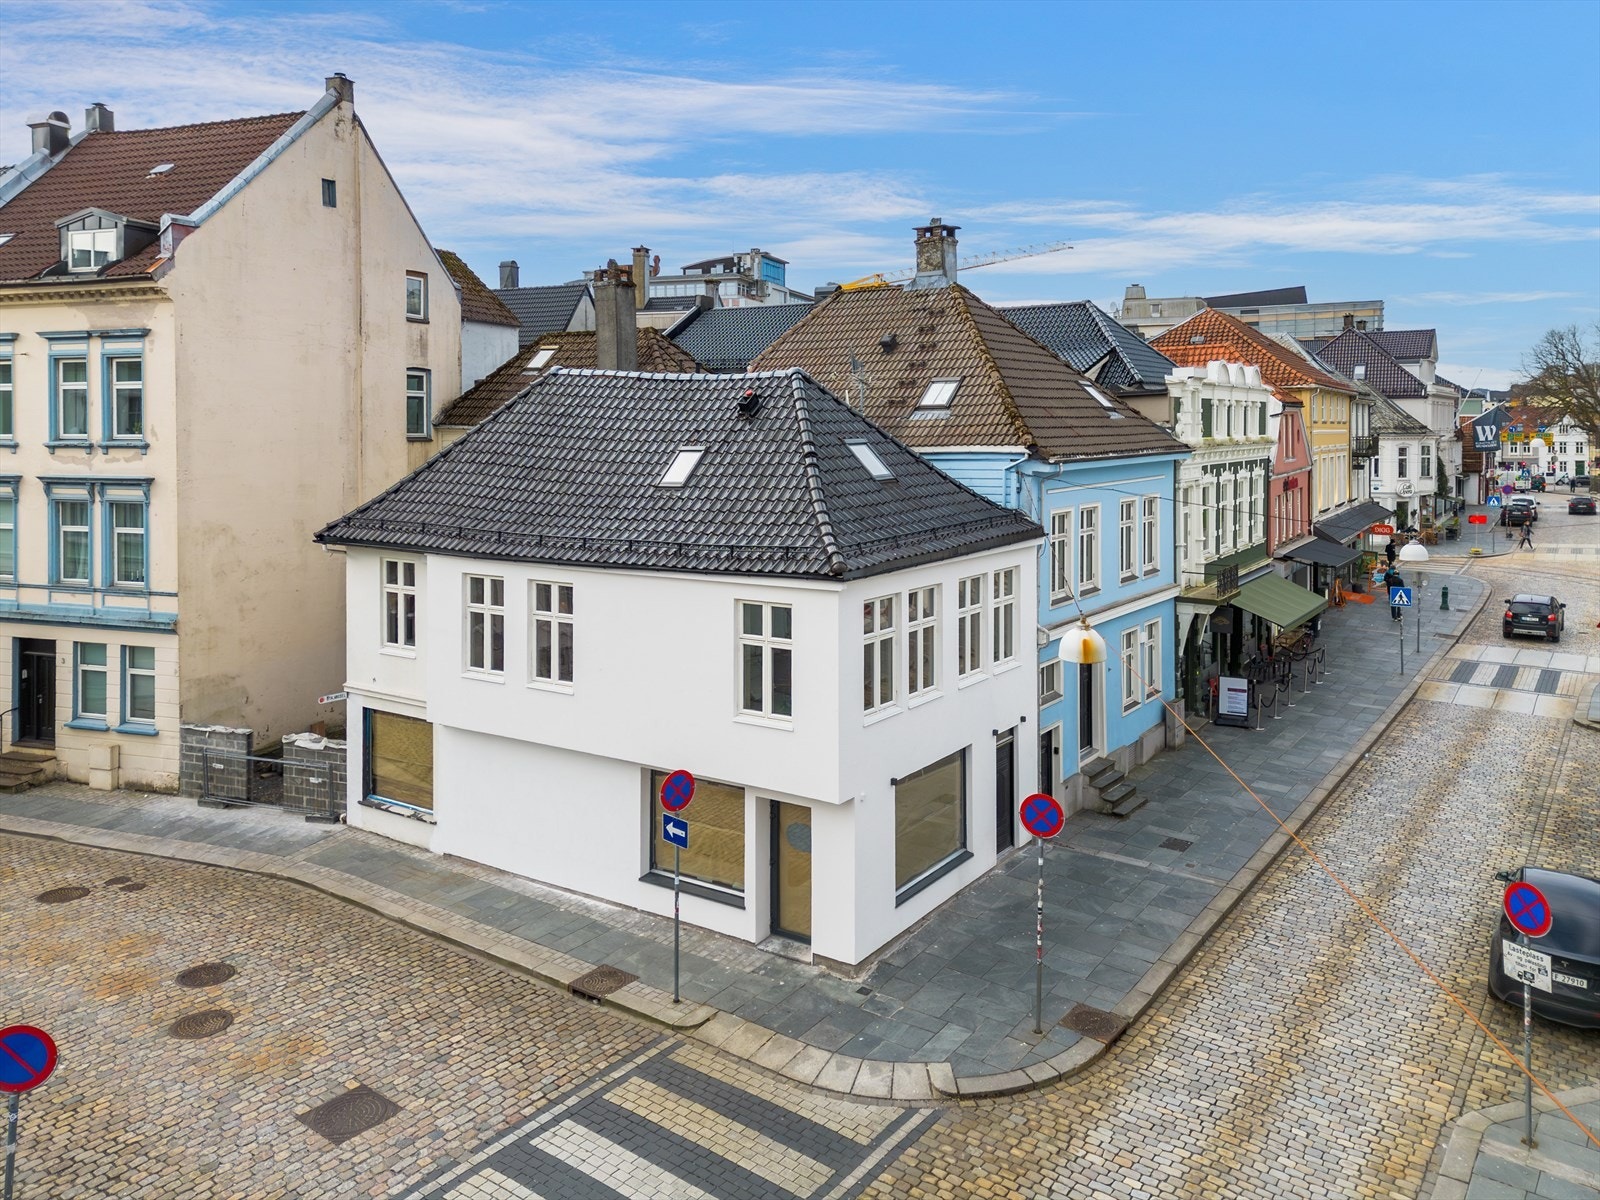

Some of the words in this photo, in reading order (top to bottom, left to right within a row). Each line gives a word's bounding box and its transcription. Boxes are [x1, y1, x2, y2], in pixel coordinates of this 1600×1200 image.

[1475, 424, 1497, 442] W
[1508, 944, 1544, 962] Lasteplass
[1562, 975, 1584, 986] 27910
